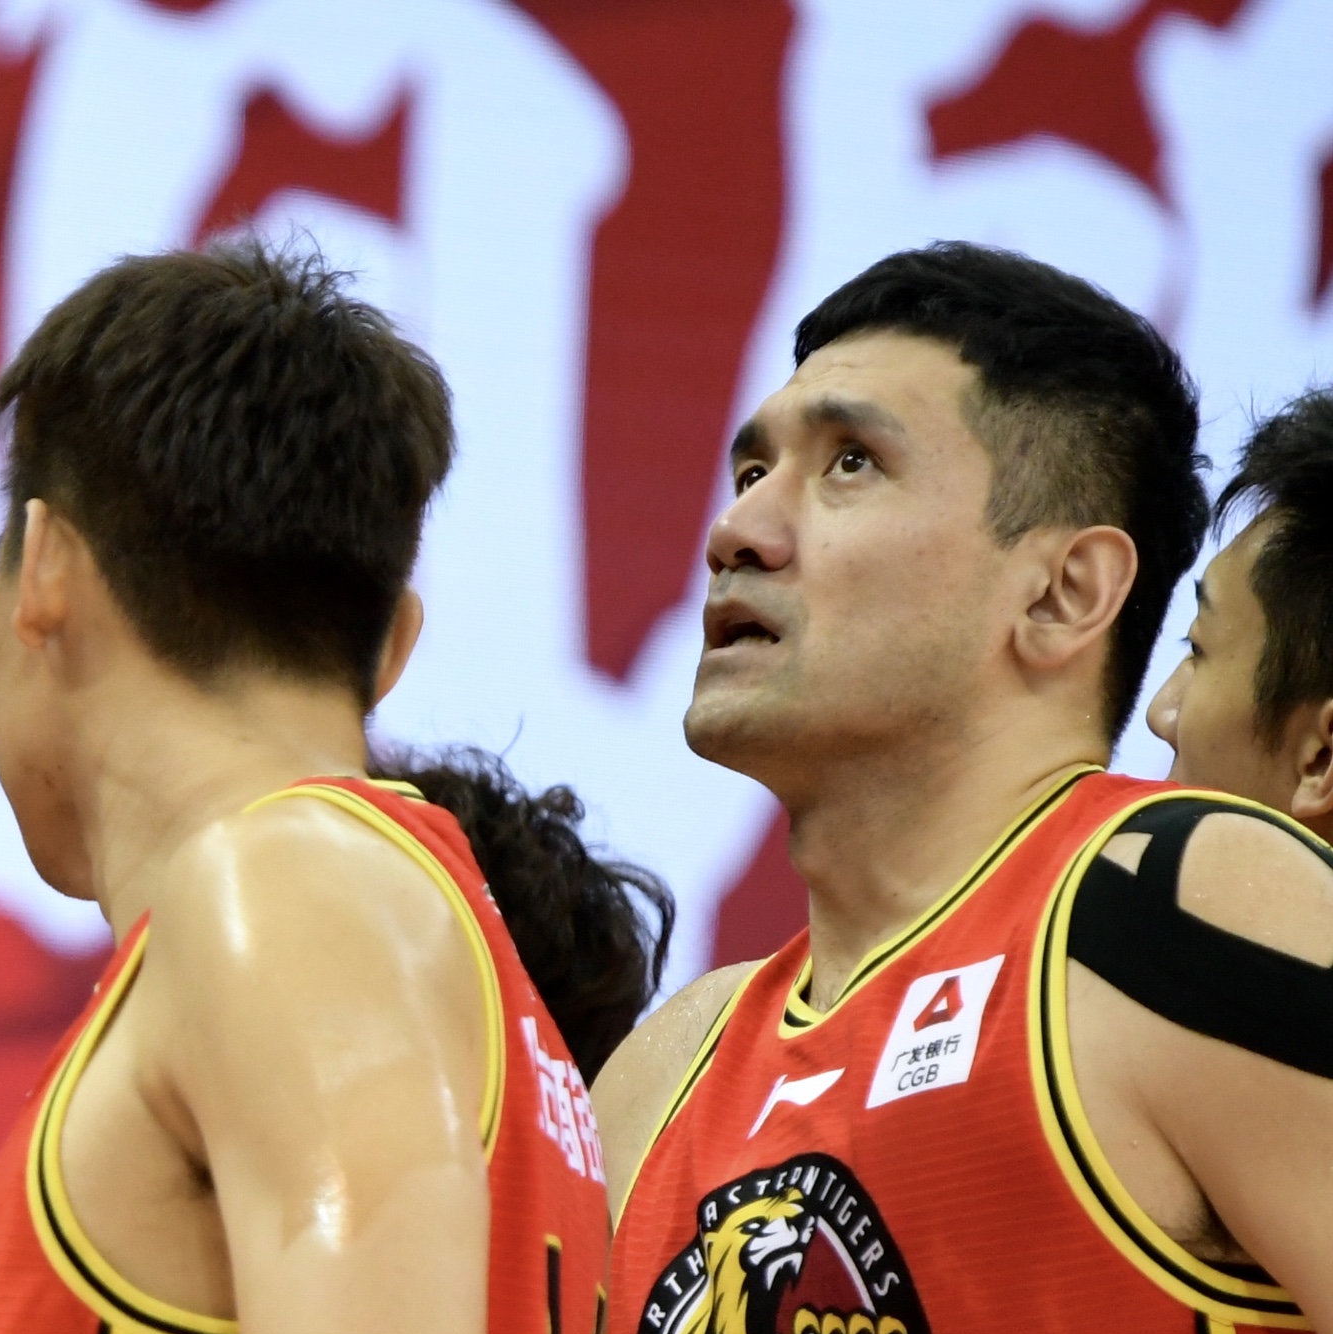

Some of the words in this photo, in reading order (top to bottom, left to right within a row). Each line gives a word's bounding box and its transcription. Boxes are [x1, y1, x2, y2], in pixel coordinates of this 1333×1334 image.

[890, 1033, 963, 1073] 广发银行
[897, 1063, 940, 1092] CGB
[820, 1171, 900, 1297] TIGERS
